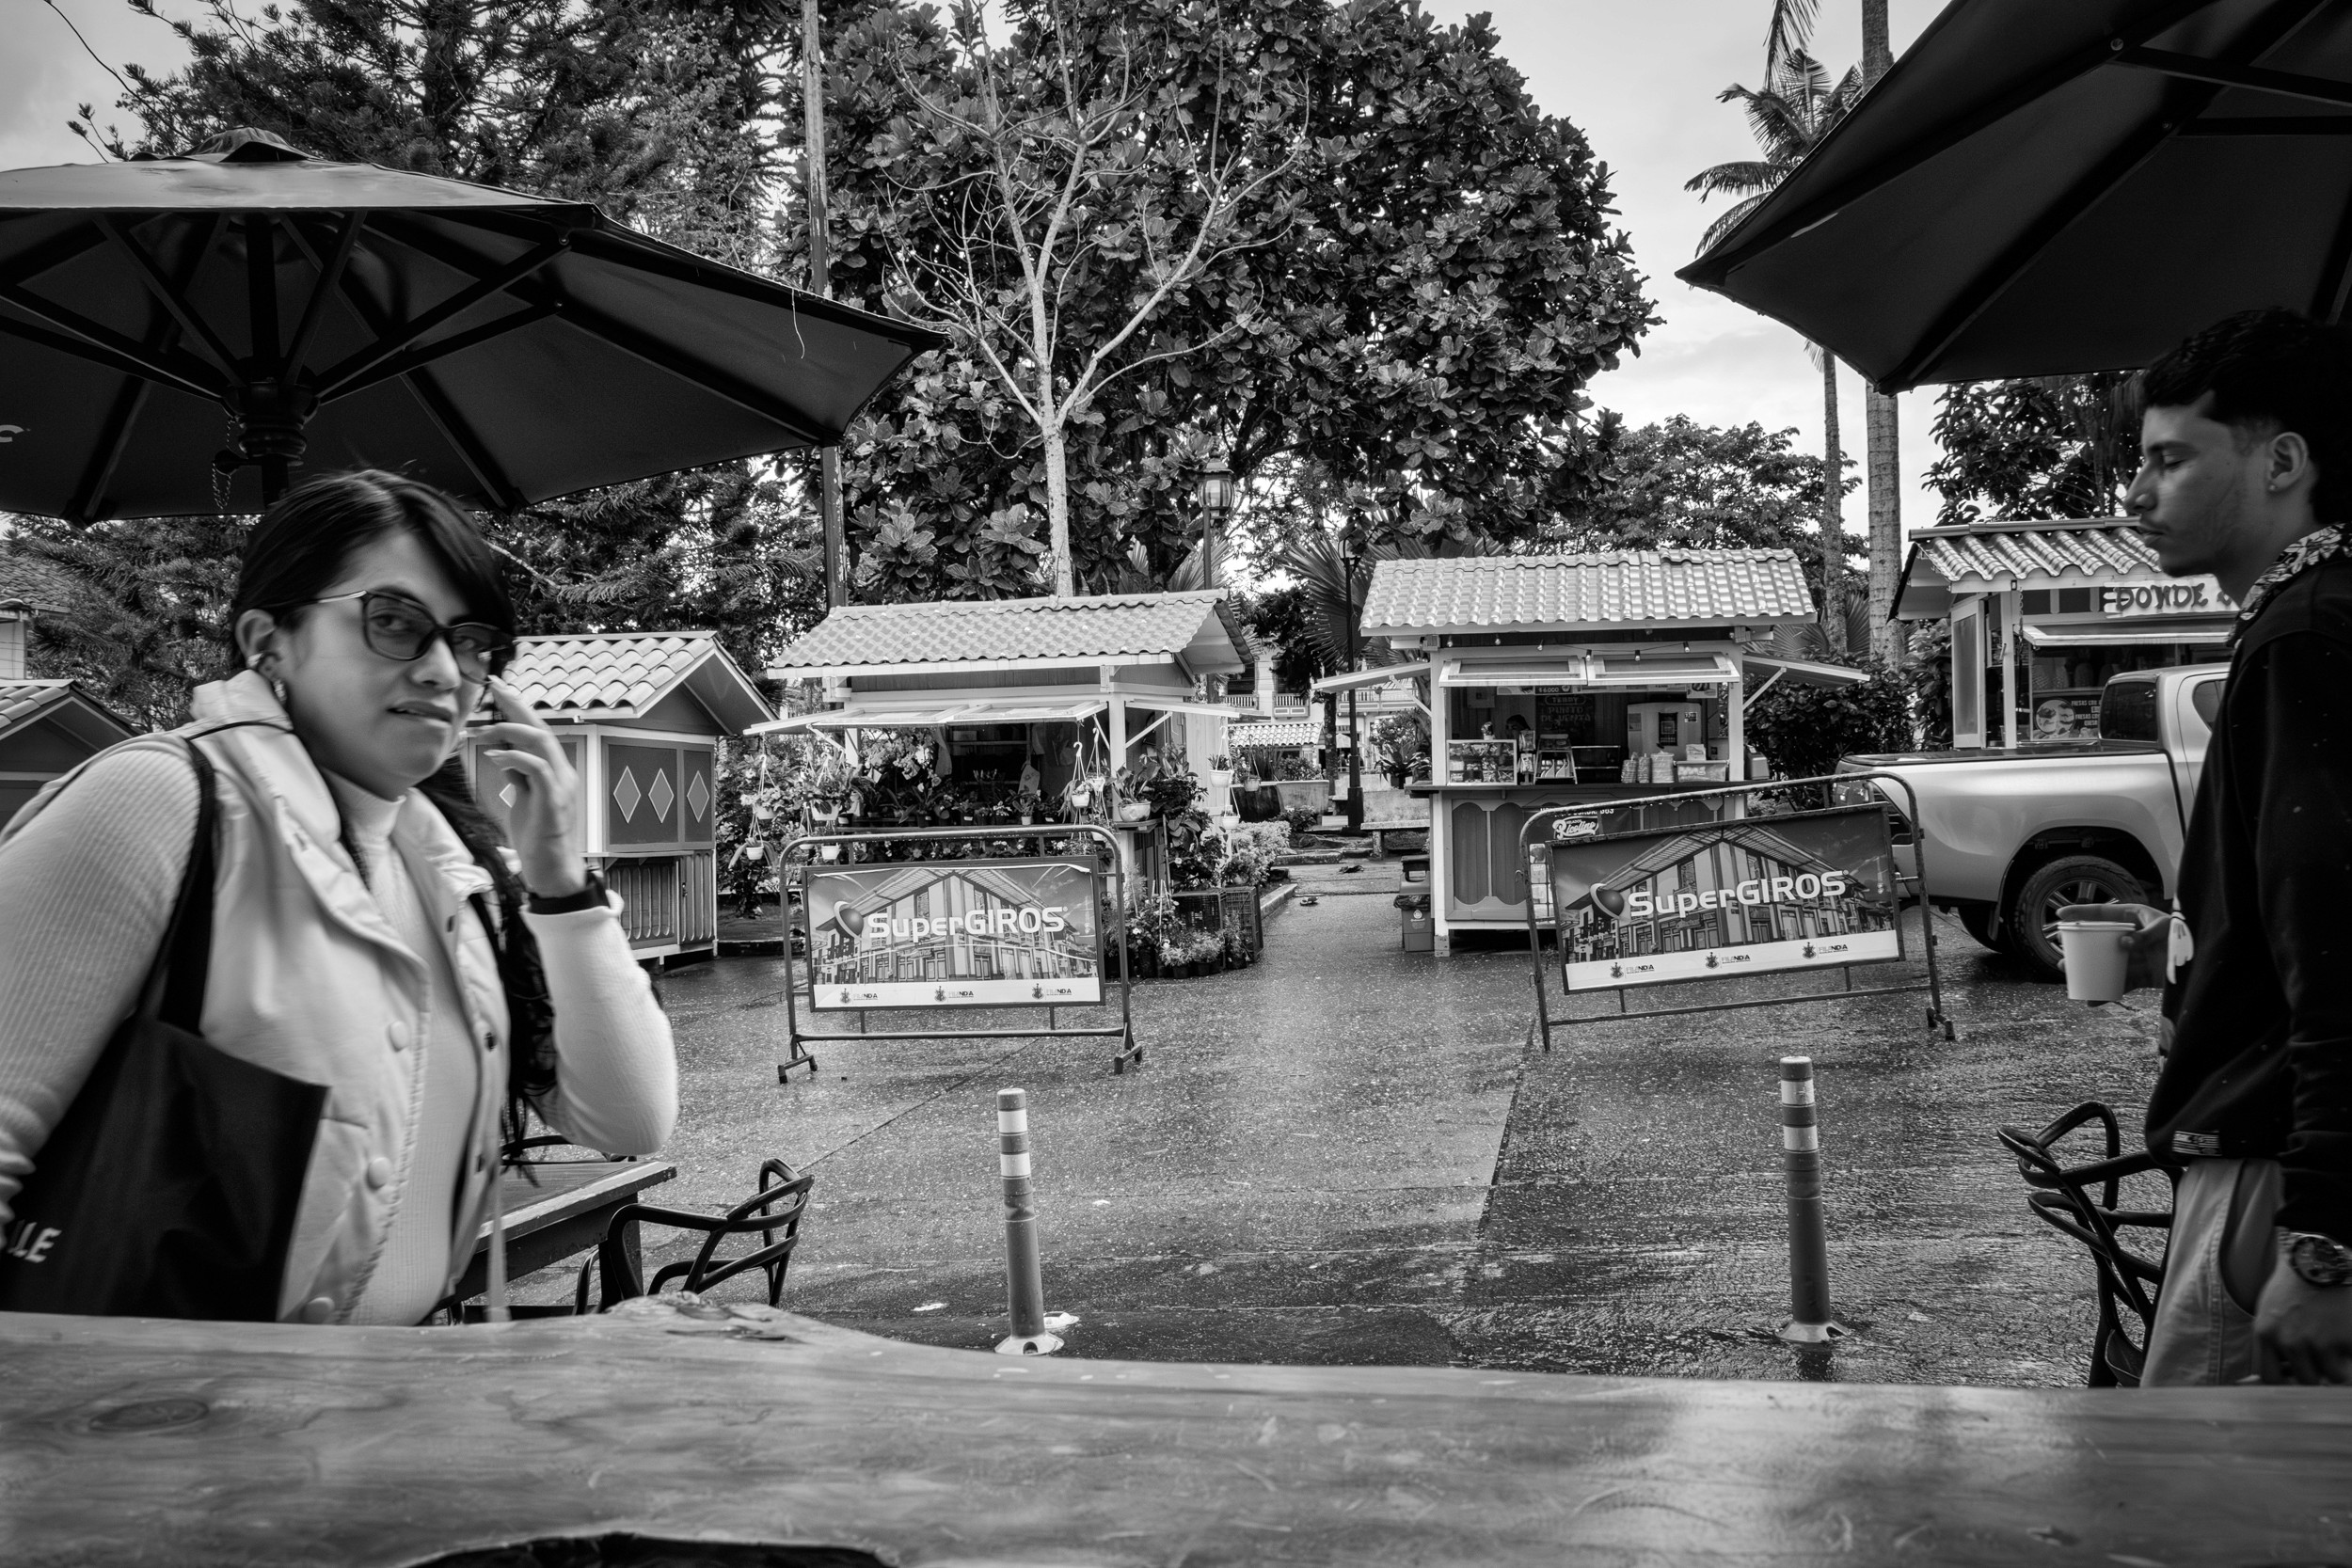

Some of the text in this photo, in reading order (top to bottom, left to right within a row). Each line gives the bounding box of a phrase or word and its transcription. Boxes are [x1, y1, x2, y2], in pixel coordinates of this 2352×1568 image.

[2113, 583, 2208, 610] DONDE
[1628, 870, 1846, 918] SuperGIROS
[867, 906, 1066, 943] SuperGIROS
